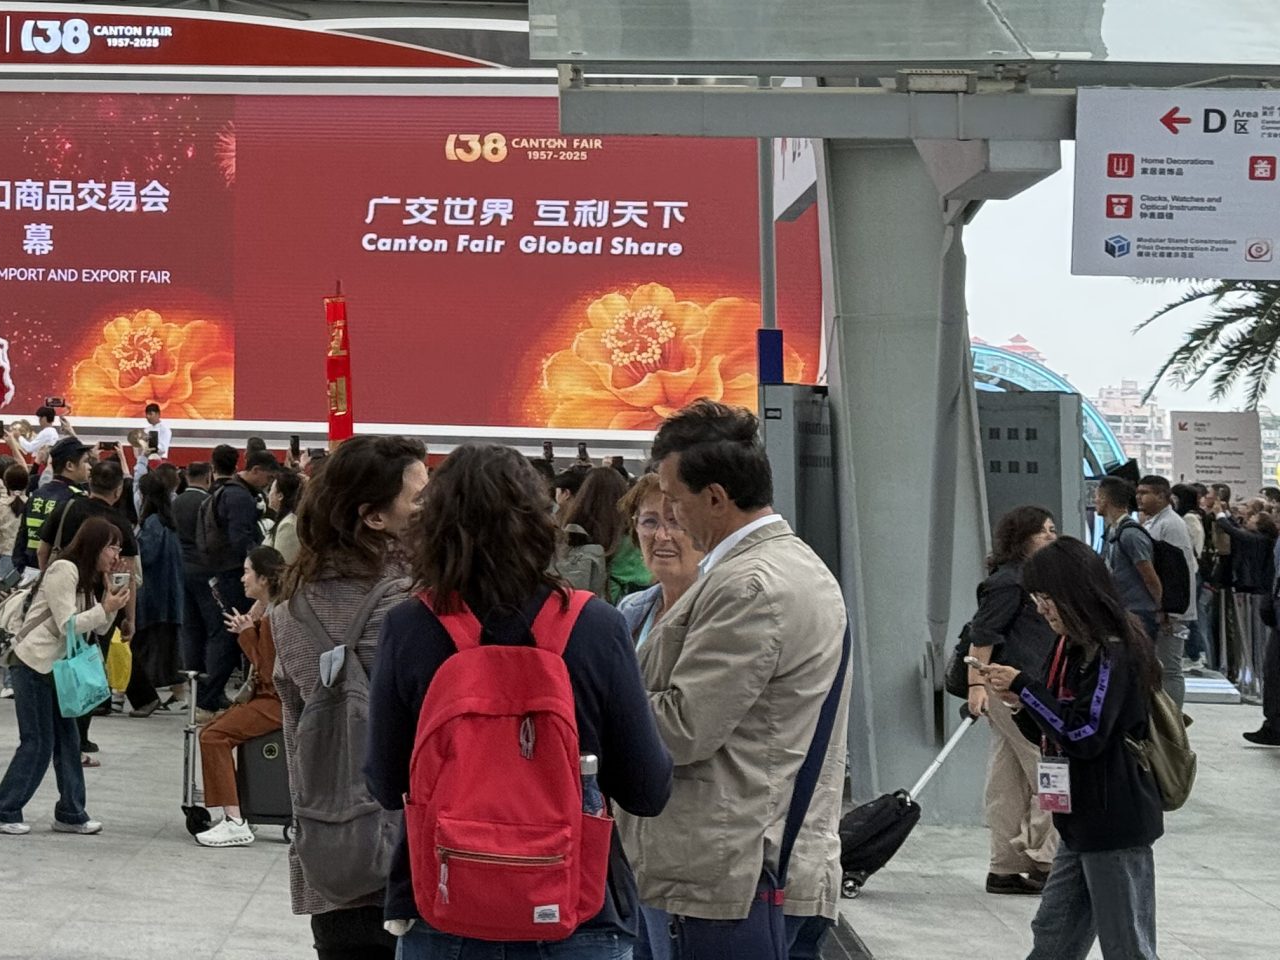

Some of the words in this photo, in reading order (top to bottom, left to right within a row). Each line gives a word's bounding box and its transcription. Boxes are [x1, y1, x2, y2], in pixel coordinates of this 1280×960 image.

[21, 18, 91, 54] 138
[93, 25, 142, 36] CANTON
[145, 26, 173, 37] FAIR
[107, 37, 160, 48] 1957-2025
[1203, 108, 1227, 133] D
[1233, 109, 1259, 118] Area
[1234, 119, 1249, 134] 区
[445, 132, 508, 162] 138
[511, 138, 567, 149] CANTON
[573, 138, 603, 150] FAIR
[527, 151, 588, 161] 1957-2025
[1166, 157, 1214, 165] Decorations
[365, 196, 514, 226] 广交世界
[533, 199, 688, 229] 互利天下
[1140, 203, 1168, 211] Optical
[1169, 204, 1217, 212] Instruments
[361, 233, 448, 252] Canton
[457, 235, 506, 253] Fair
[519, 235, 602, 255] Global
[610, 237, 683, 256] Share
[47, 269, 78, 281] AND
[81, 269, 137, 283] EXPORT
[140, 270, 171, 283] FAIR
